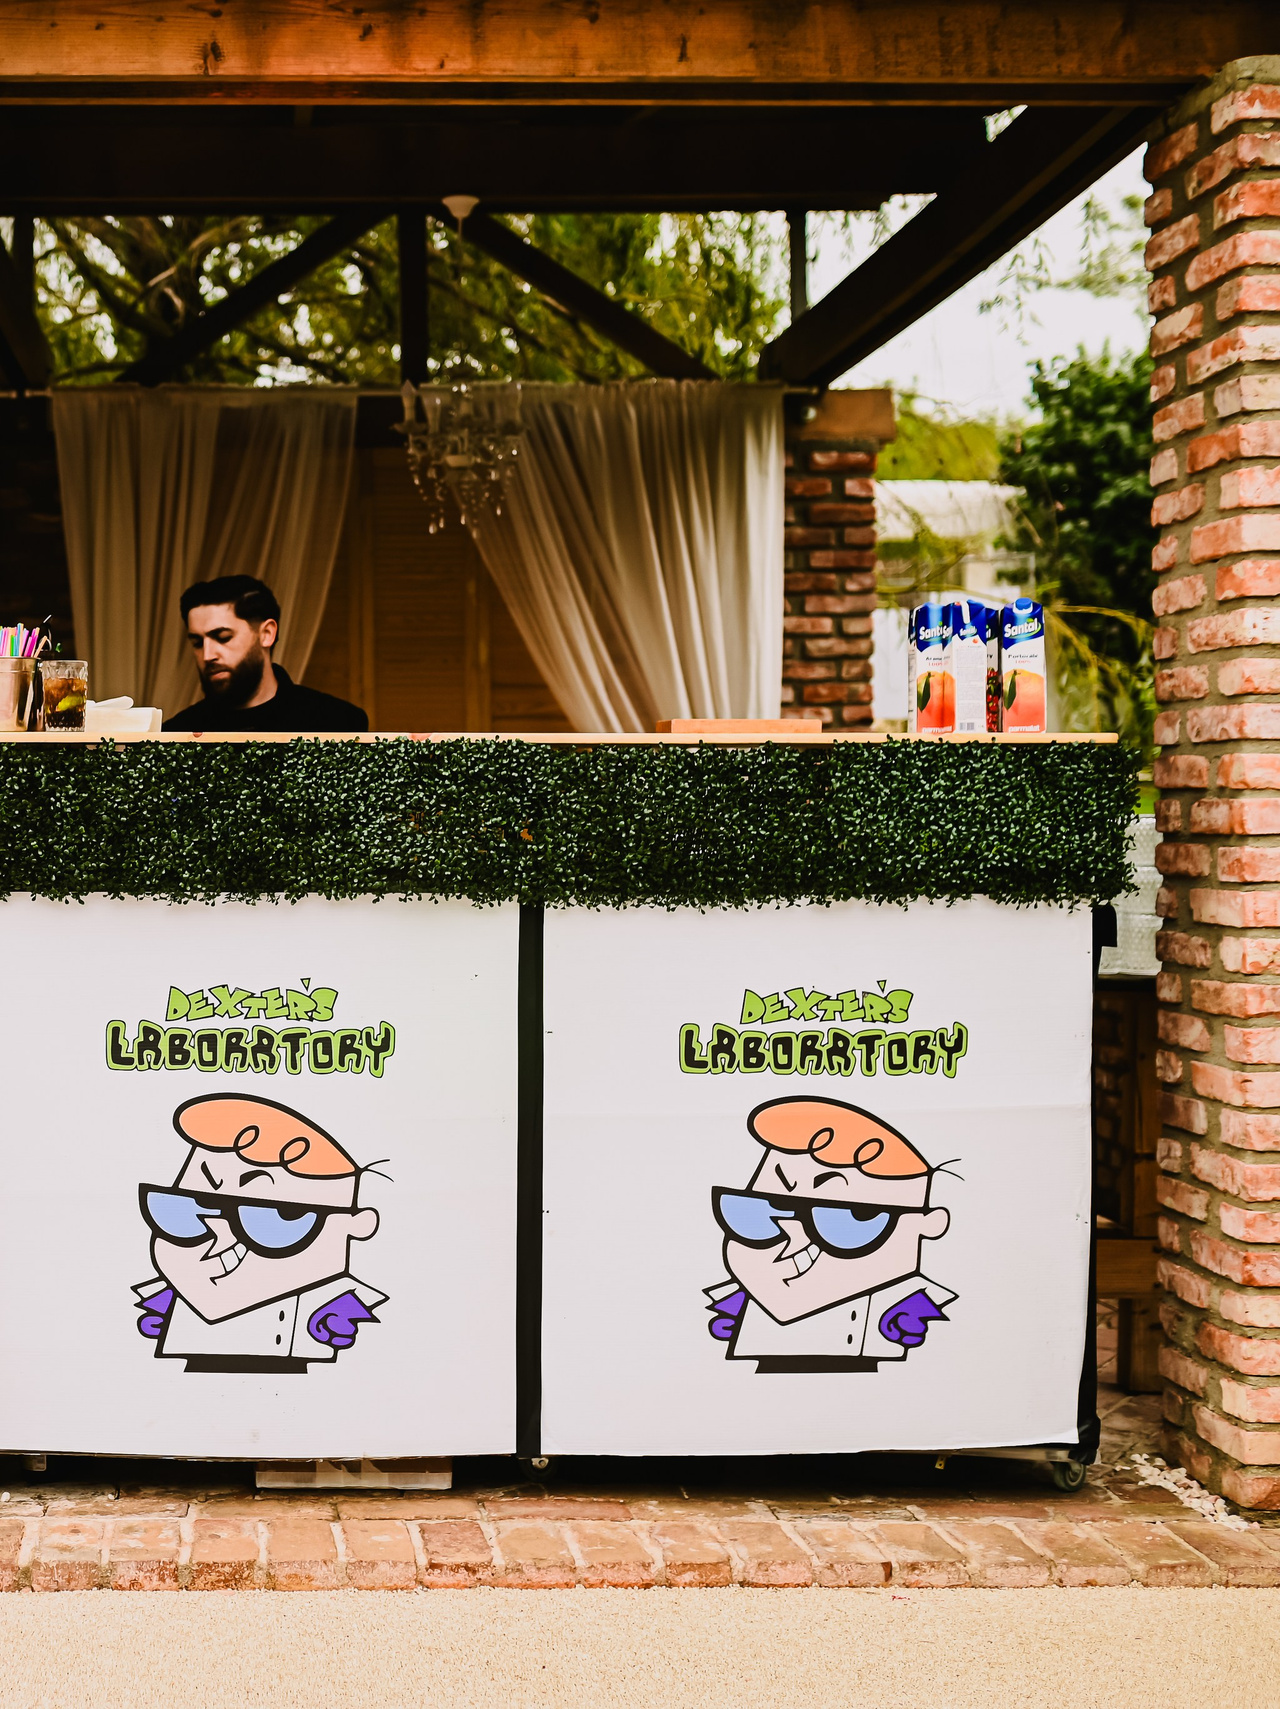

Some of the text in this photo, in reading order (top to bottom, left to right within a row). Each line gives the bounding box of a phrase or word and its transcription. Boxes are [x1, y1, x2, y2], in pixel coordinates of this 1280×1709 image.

[1004, 618, 1038, 638] Santal
[165, 977, 339, 1022] DEXTER'S
[740, 979, 914, 1025] DEXTER'S
[106, 1019, 396, 1079] LABORATORY
[679, 1021, 969, 1079] LABORATORY
